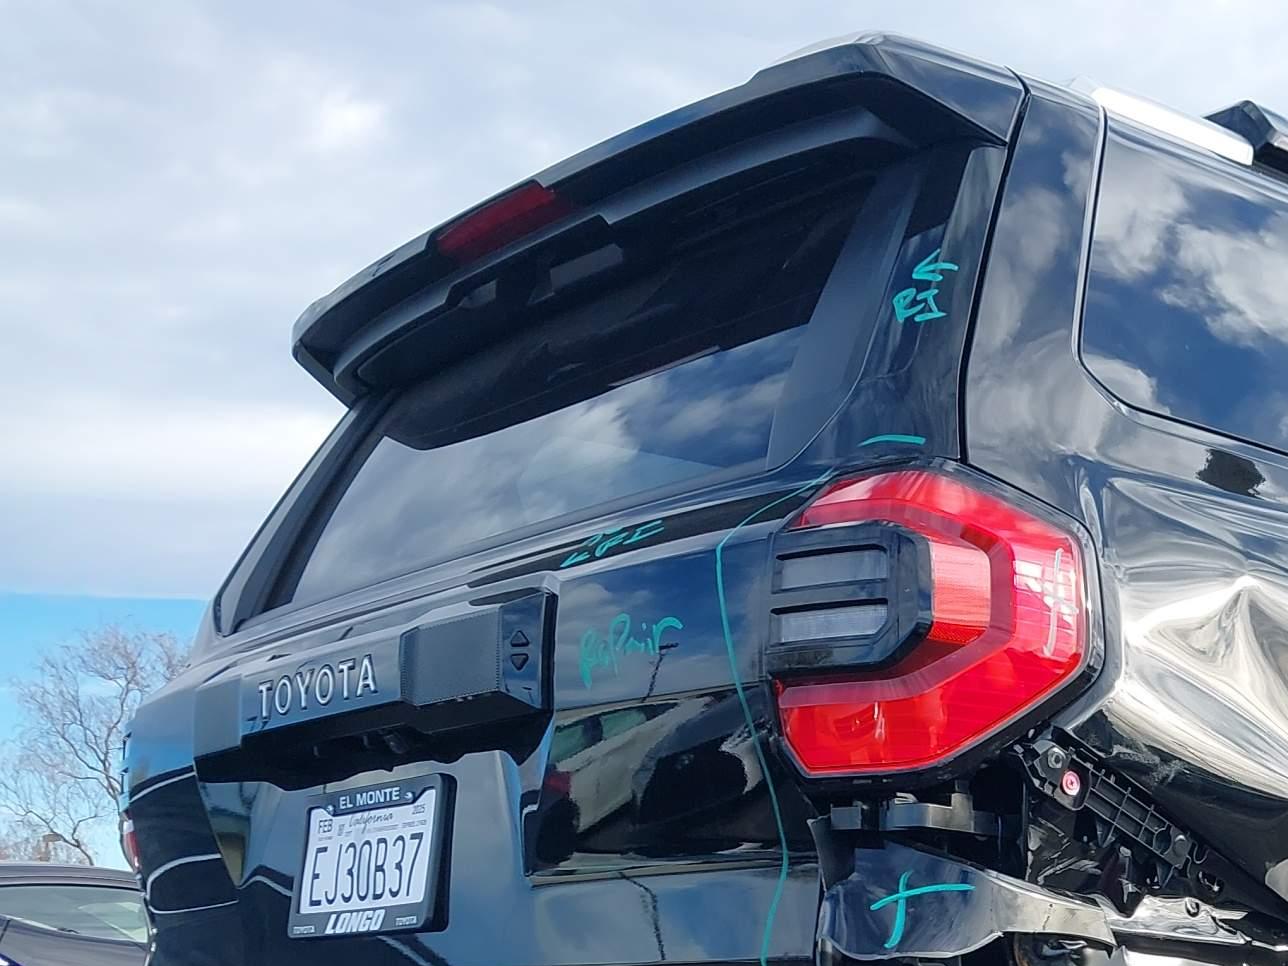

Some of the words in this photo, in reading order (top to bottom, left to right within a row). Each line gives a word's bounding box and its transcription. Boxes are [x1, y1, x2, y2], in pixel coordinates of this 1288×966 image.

[258, 653, 379, 720] TOYOTA
[339, 796, 353, 810] EL
[356, 787, 400, 806] MONTE
[318, 818, 333, 834] FEB
[349, 811, 393, 834] California
[309, 832, 424, 907] EJ30B37
[324, 909, 386, 934] LONGO
